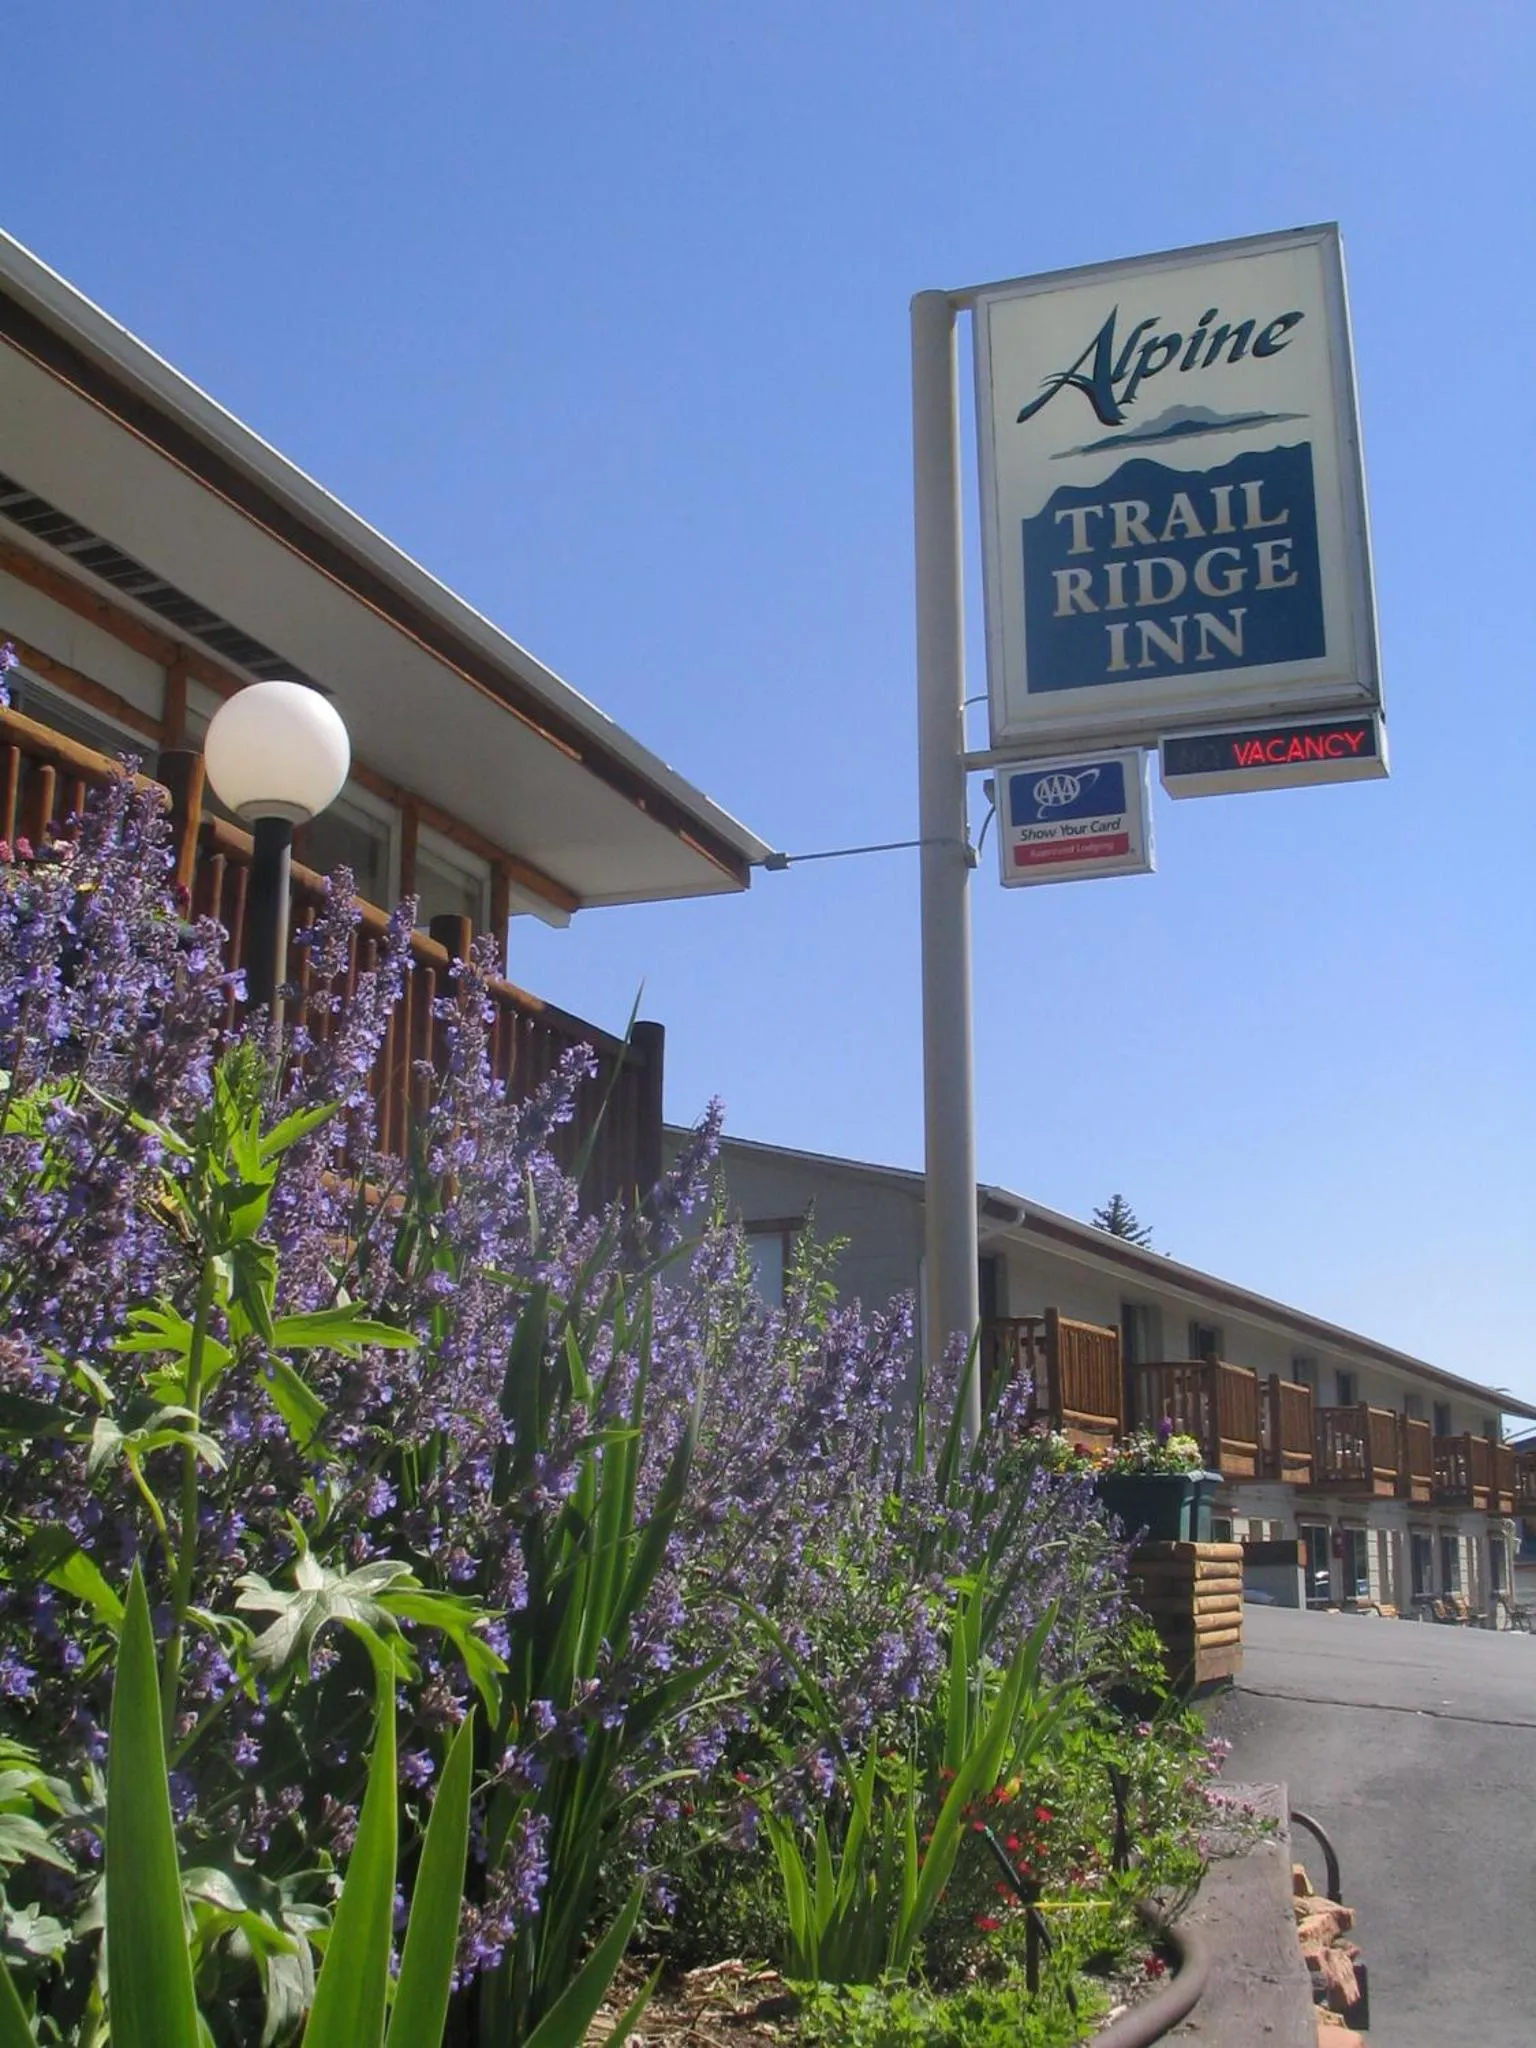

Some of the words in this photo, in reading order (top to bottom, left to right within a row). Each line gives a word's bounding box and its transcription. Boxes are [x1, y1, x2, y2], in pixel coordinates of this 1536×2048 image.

[1016, 304, 1305, 427] Alpine
[1054, 479, 1290, 556] TRAIL
[1051, 537, 1299, 617] RIDGE
[1105, 607, 1248, 673] INN
[1232, 730, 1365, 767] VACANCY
[1036, 774, 1079, 806] AAA
[1021, 827, 1058, 842] Show
[1060, 821, 1088, 836] Your
[1090, 818, 1122, 833] Card
